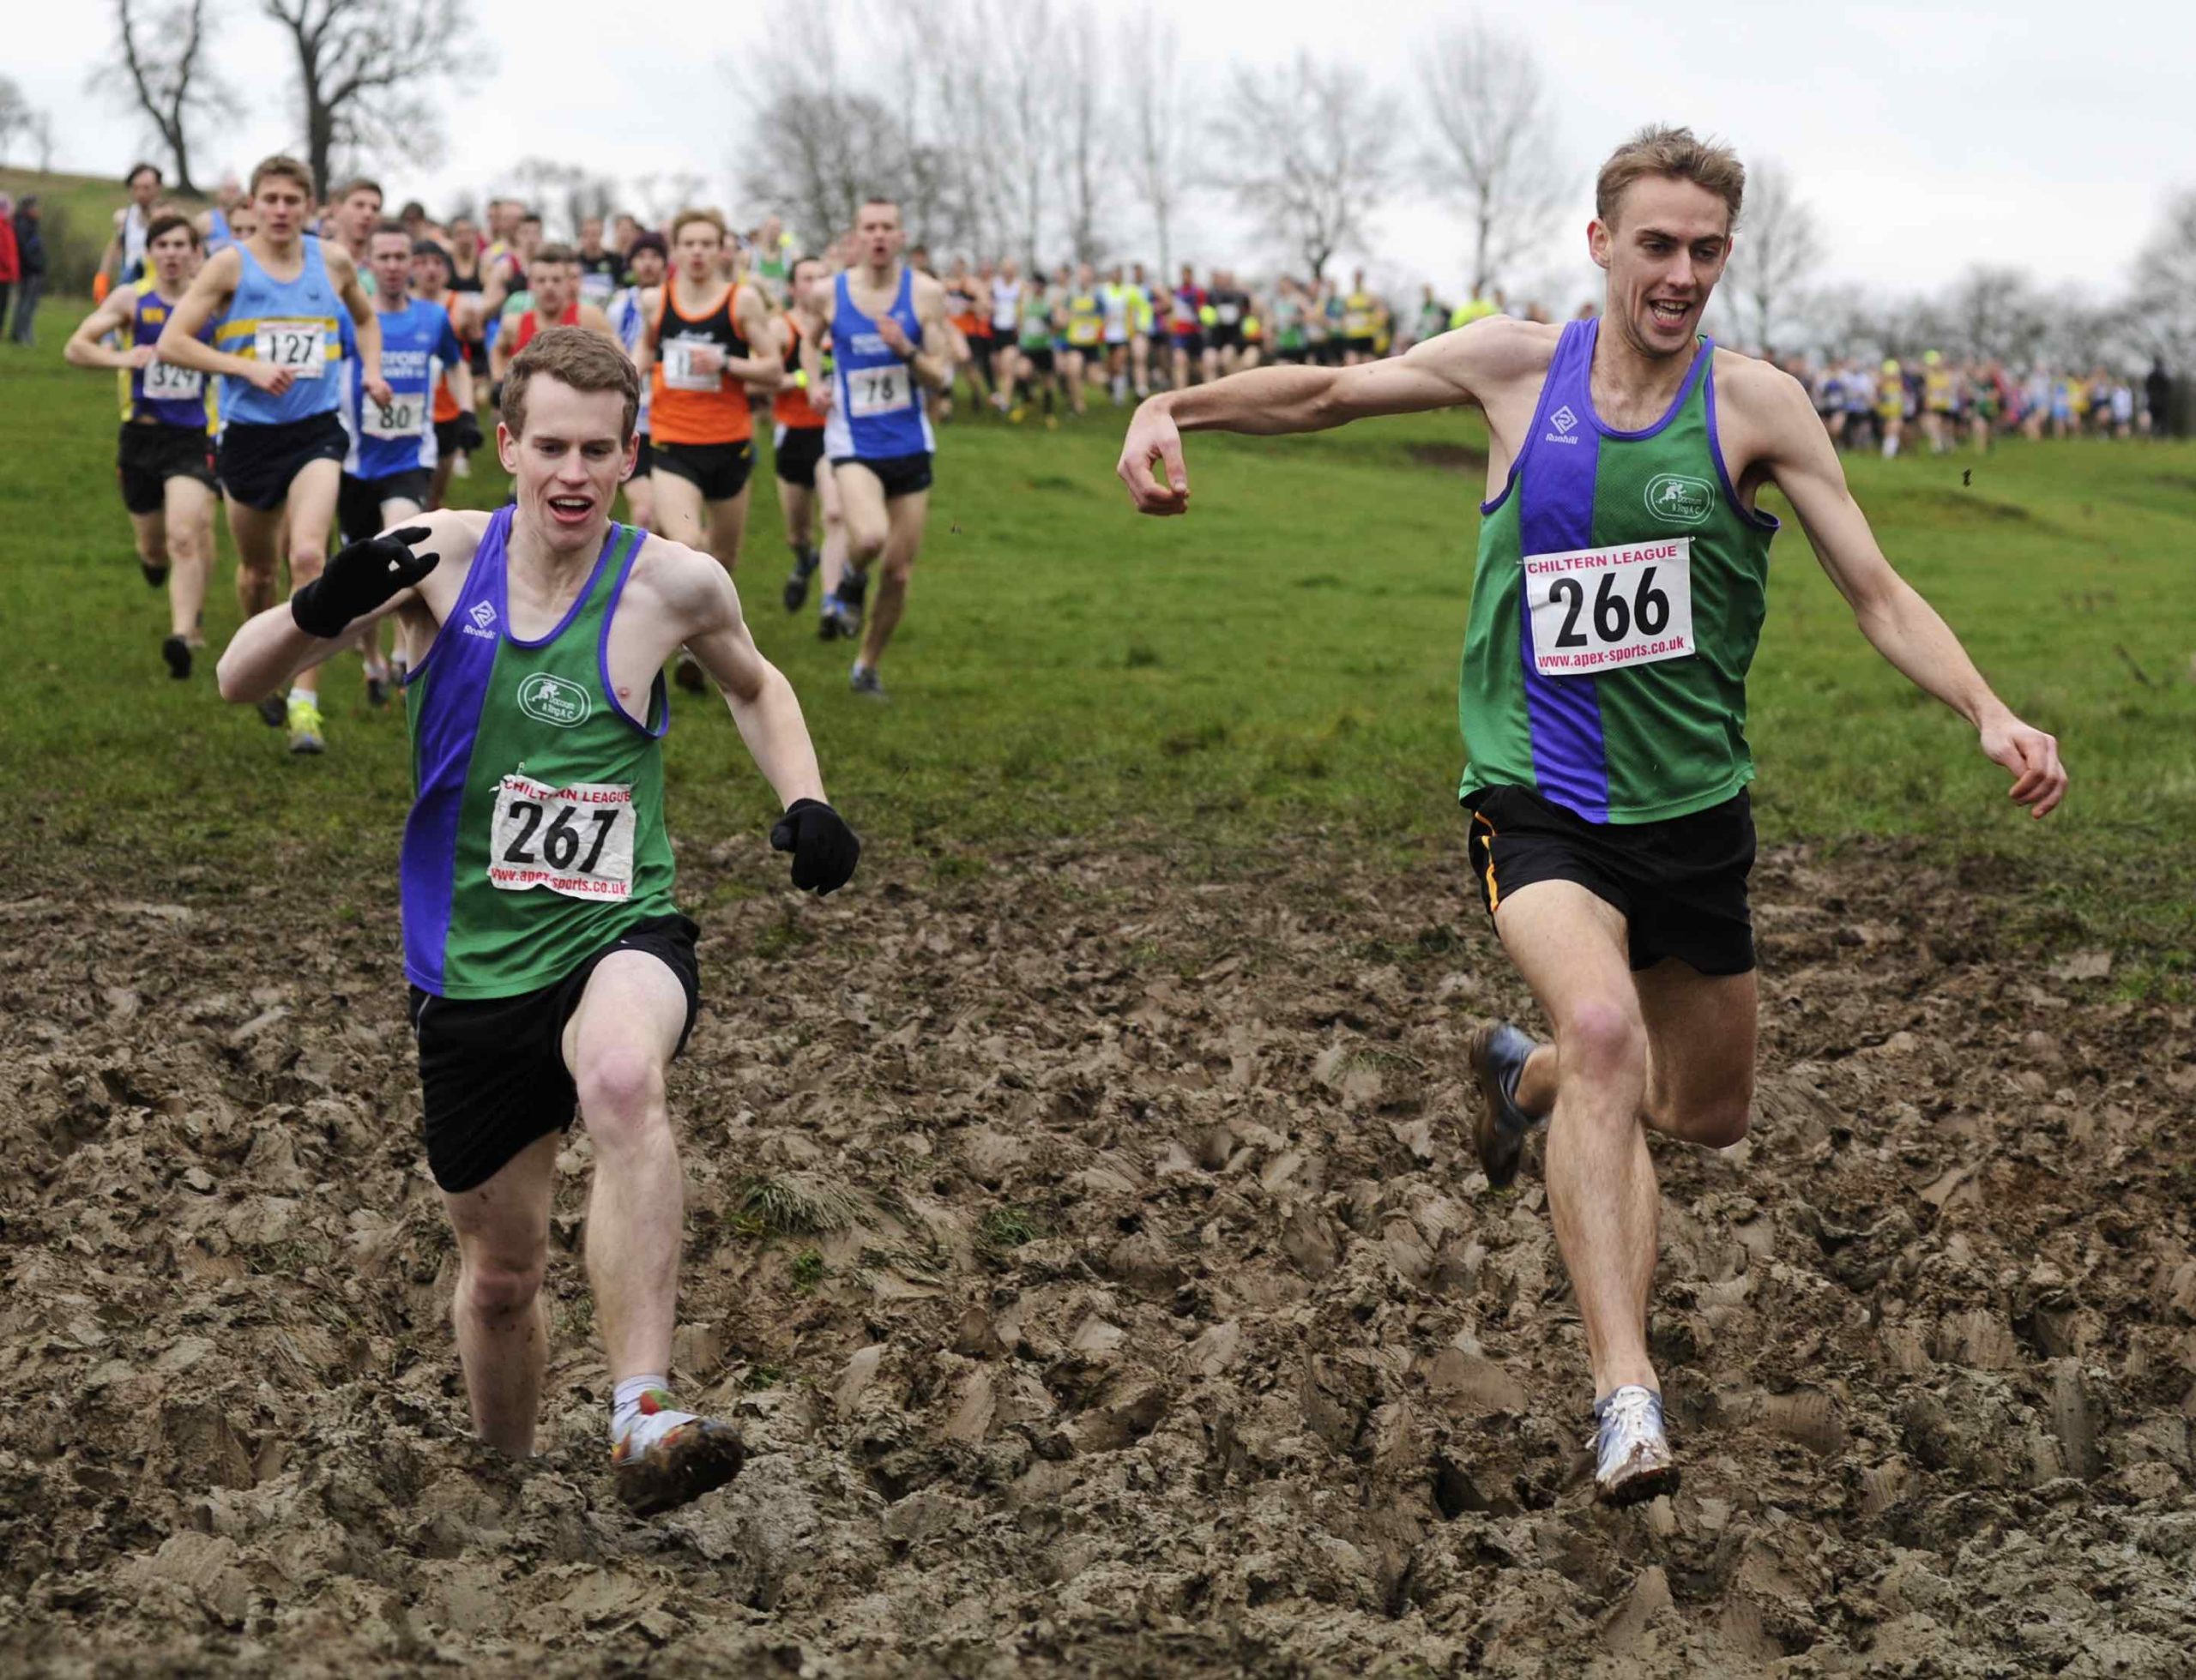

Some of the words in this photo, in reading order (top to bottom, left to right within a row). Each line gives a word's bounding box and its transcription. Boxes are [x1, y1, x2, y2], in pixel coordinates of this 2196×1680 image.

[270, 334, 315, 364] 127
[379, 397, 412, 429] 80
[1528, 555, 1608, 574] CHILTERN
[1613, 545, 1678, 564] LEAGUE
[1548, 566, 1670, 648] 266
[1537, 635, 1685, 668] www.apex-sports.co.uk
[582, 790, 632, 804] LEAGUE
[503, 800, 620, 874] 267
